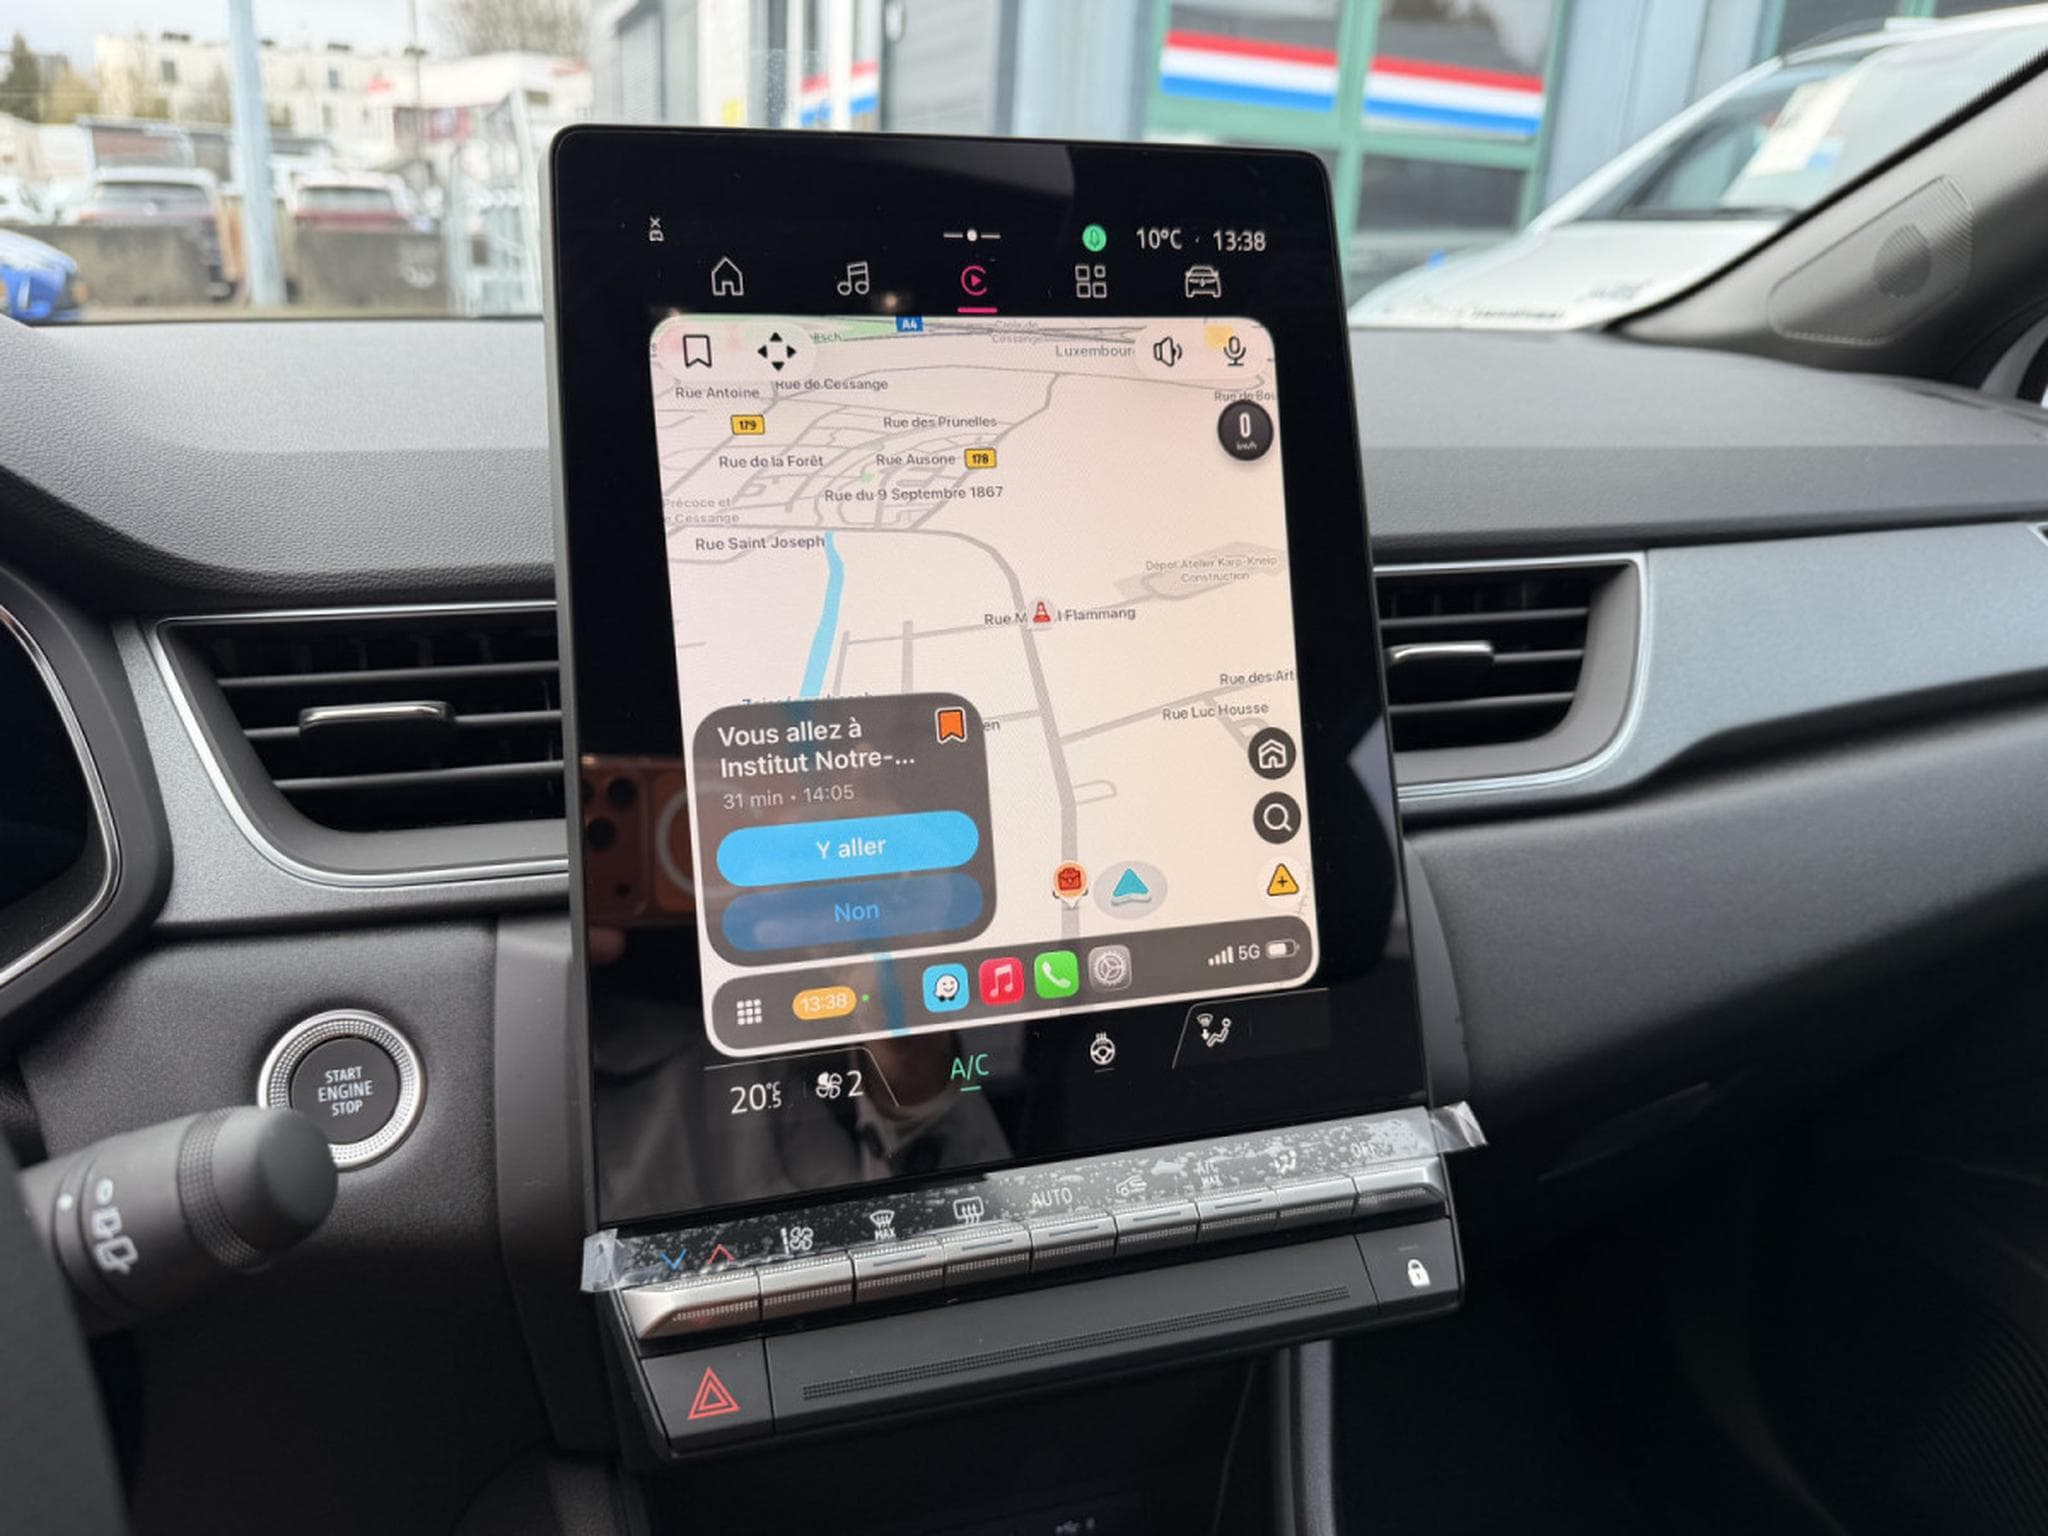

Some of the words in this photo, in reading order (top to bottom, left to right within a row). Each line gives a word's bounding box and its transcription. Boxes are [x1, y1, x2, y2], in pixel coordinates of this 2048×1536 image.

[1136, 227, 1183, 250] 10°C
[1212, 229, 1267, 252] 13:38
[675, 387, 702, 399] Rue
[706, 387, 760, 399] Antoine
[775, 379, 800, 390] Rue
[804, 378, 821, 390] de
[824, 378, 888, 392] Cessange
[738, 420, 757, 431] 179
[883, 416, 909, 428] Rue
[911, 416, 935, 428] des
[937, 416, 998, 428] Prunelles
[1239, 412, 1251, 438] 0
[719, 456, 746, 468] Rue
[750, 455, 768, 467] de
[771, 455, 784, 467] la
[787, 453, 823, 467] Forêt
[876, 453, 902, 465] Rue
[906, 453, 956, 465] Ausone
[972, 453, 989, 464] 178
[825, 488, 852, 501] Rue
[856, 488, 875, 501] du
[878, 488, 887, 500] 9
[891, 486, 966, 501] Septembre
[971, 485, 1003, 498] 1867
[675, 513, 739, 524] Cessange
[695, 538, 724, 551] Rue
[728, 537, 766, 549] Saint
[770, 536, 825, 550] Joseph
[984, 613, 1011, 625] Rue
[1065, 608, 1136, 621] Flammang
[1219, 673, 1245, 685] Rue
[1248, 672, 1273, 684] des
[1162, 708, 1188, 720] Rue
[1191, 706, 1216, 719] Luc
[1218, 704, 1269, 716] Housse
[717, 724, 779, 748] Vous
[785, 720, 842, 742] allez
[848, 716, 863, 739] à
[720, 753, 808, 779] Institut
[722, 793, 744, 811] 31
[750, 788, 784, 807] min
[802, 783, 855, 803] 14:05
[816, 841, 831, 860] Y
[838, 836, 887, 858] aller
[833, 903, 881, 923] Non
[1238, 944, 1261, 961] 5G
[801, 991, 850, 1013] 13:38
[324, 1066, 363, 1083] START
[950, 1053, 990, 1081] A/C
[318, 1081, 374, 1102] ENGINE
[847, 1069, 865, 1098] 2
[331, 1099, 364, 1117] STOP
[1030, 1186, 1074, 1210] AUTO
